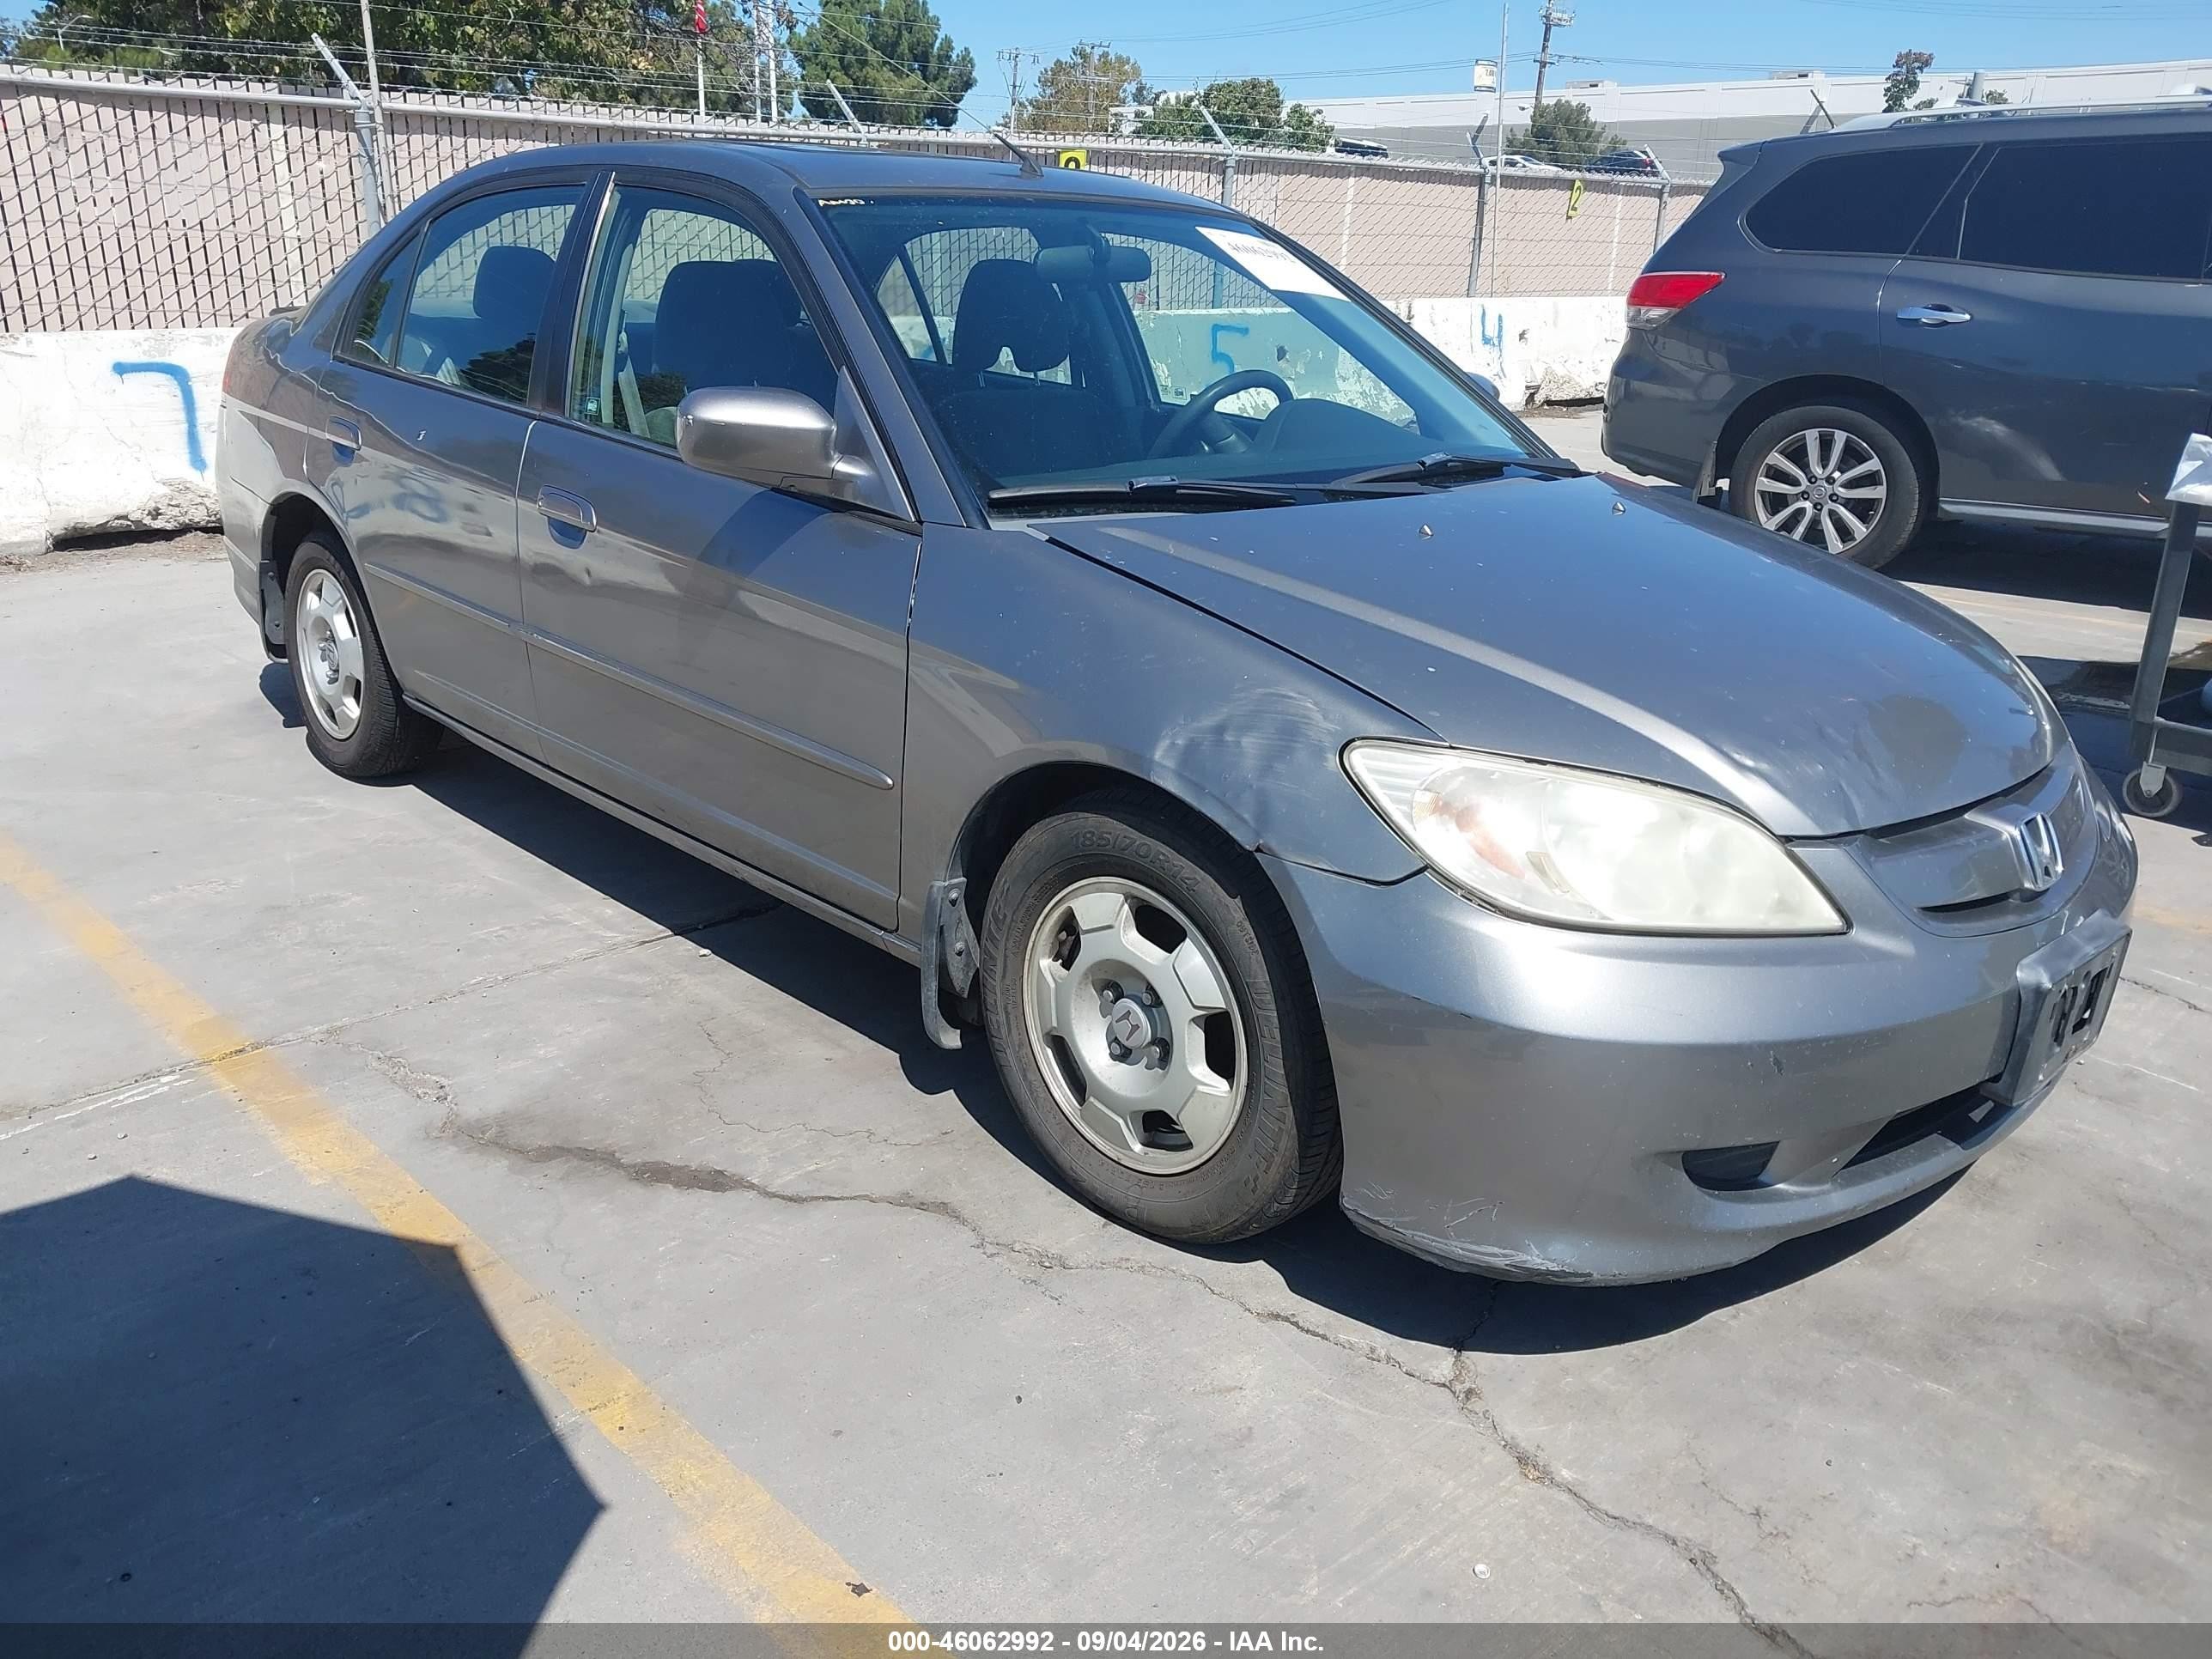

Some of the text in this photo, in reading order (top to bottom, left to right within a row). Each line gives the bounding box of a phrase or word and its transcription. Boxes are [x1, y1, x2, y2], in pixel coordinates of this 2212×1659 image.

[1571, 185, 1582, 212] 2
[1211, 323, 1249, 374] 5
[112, 362, 207, 471] 7
[1071, 830, 1201, 894] 185/70R14
